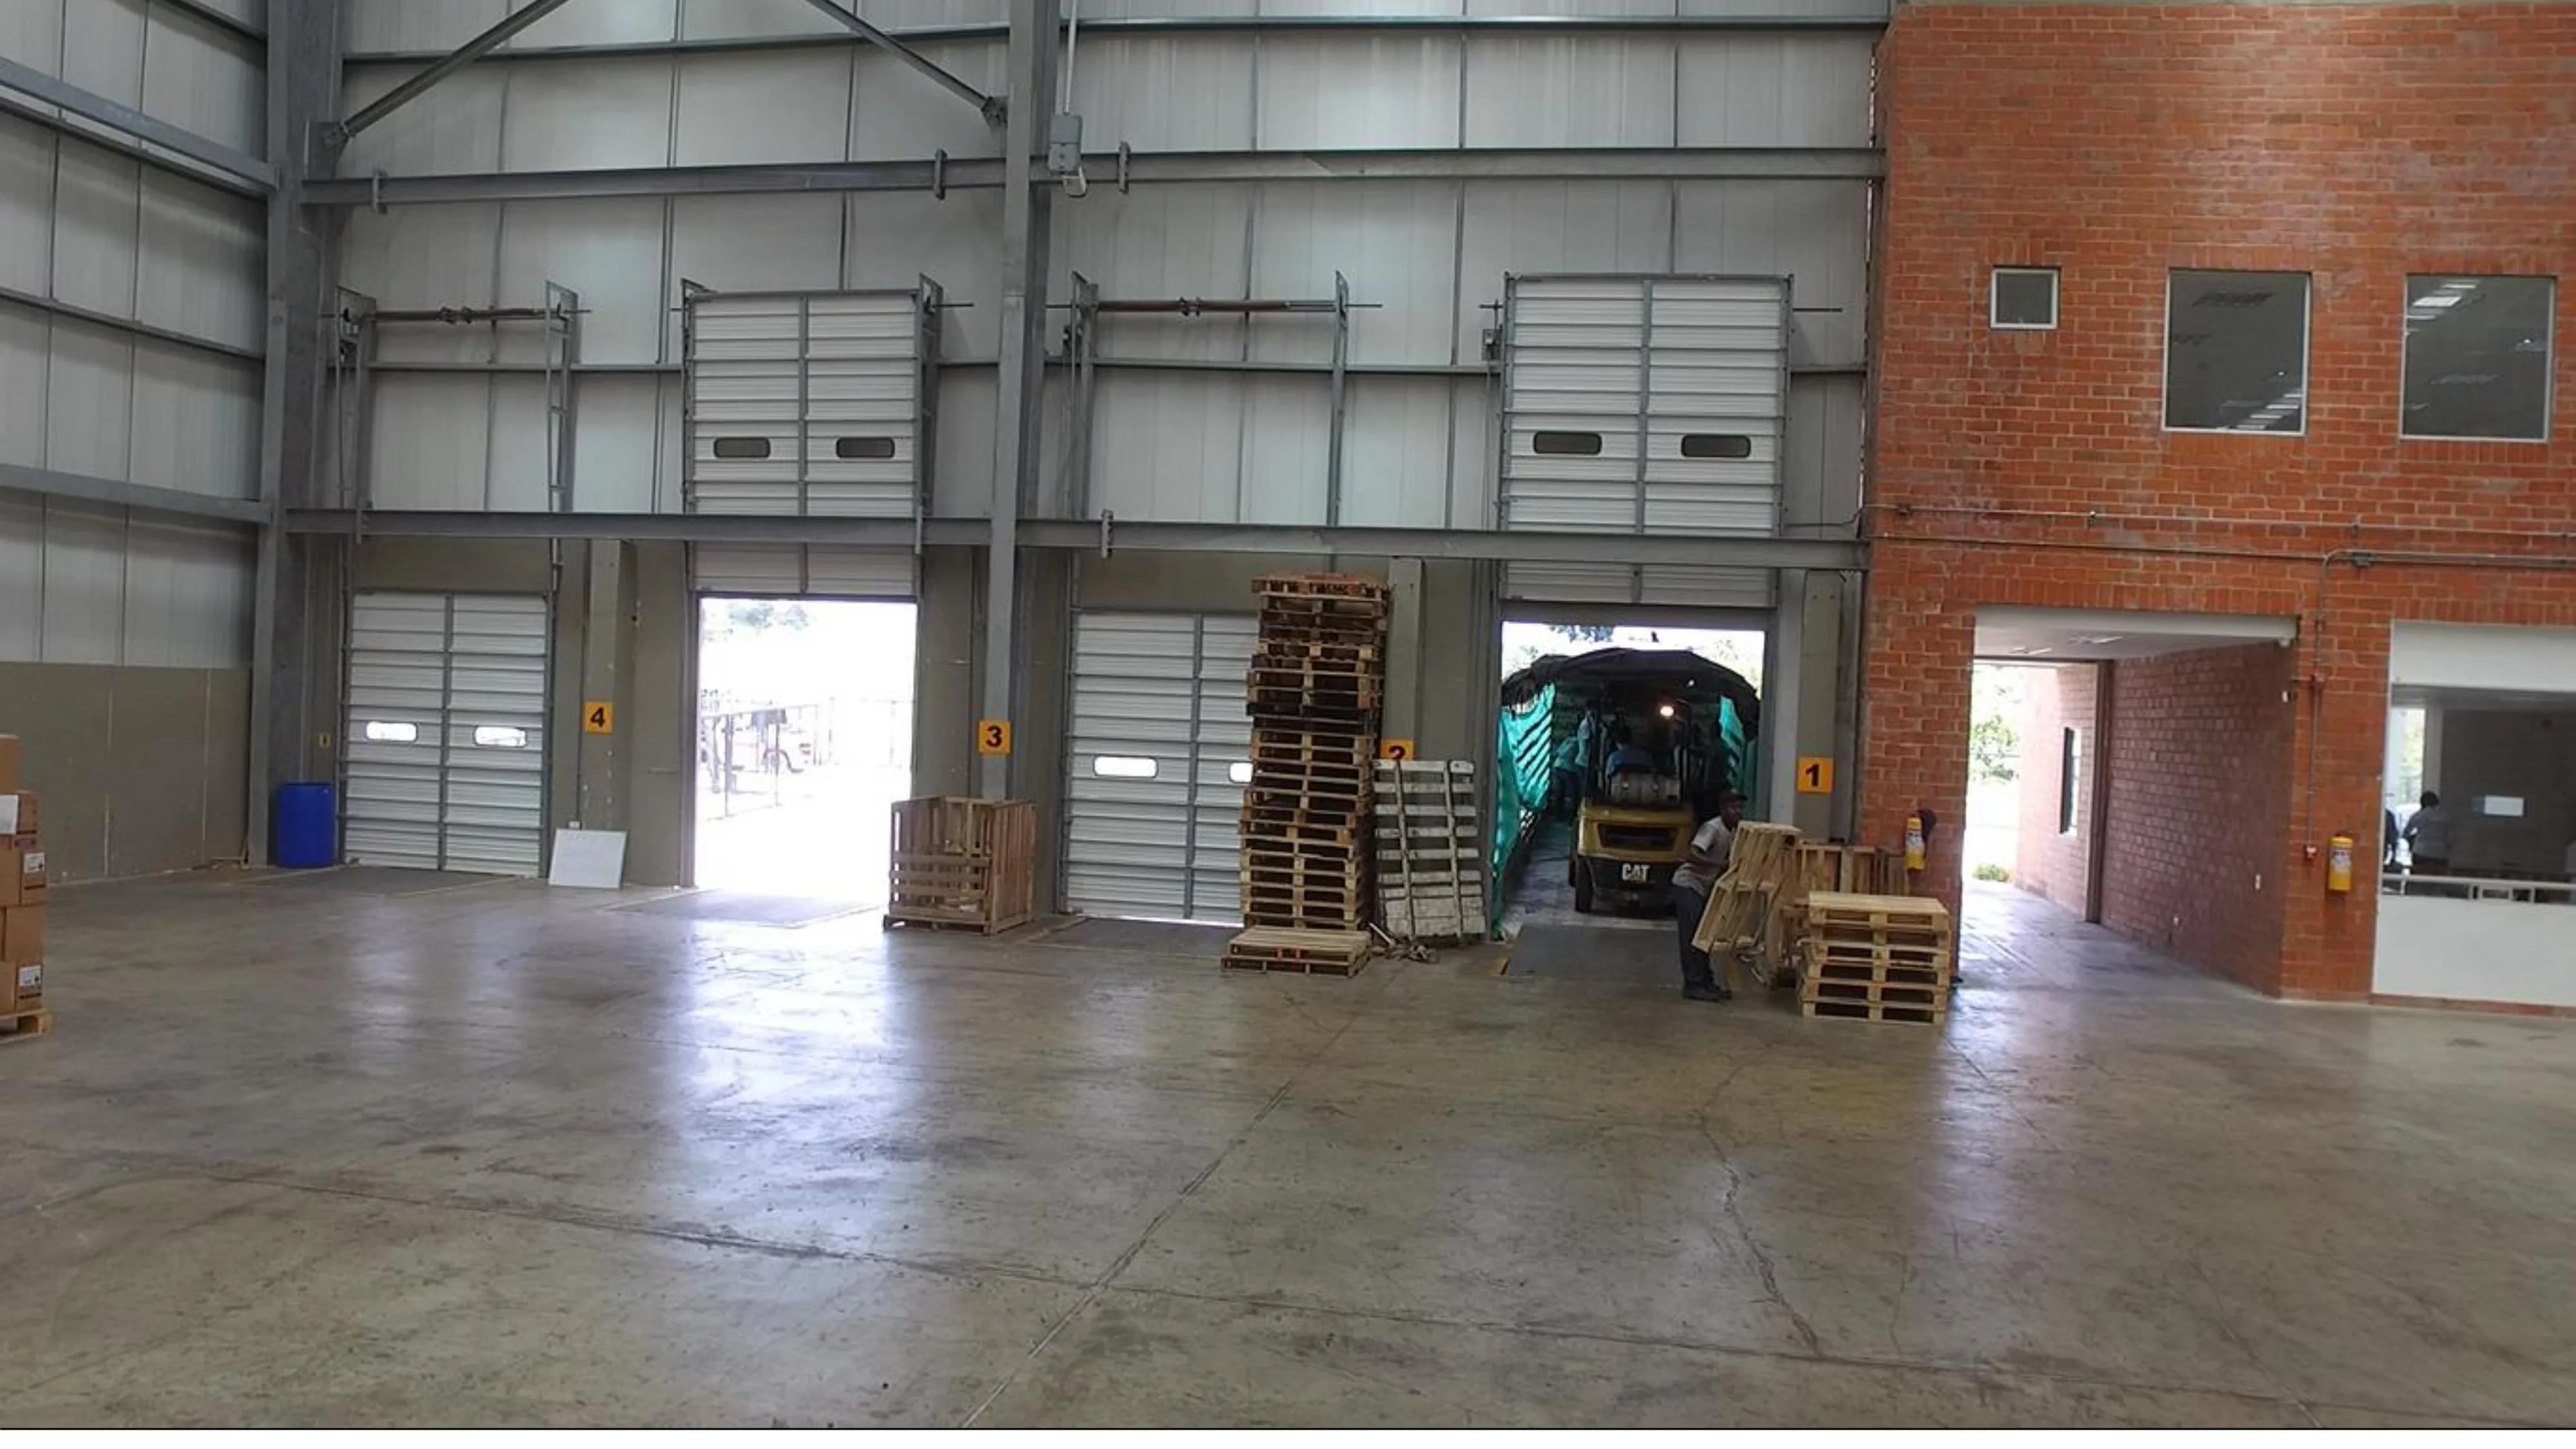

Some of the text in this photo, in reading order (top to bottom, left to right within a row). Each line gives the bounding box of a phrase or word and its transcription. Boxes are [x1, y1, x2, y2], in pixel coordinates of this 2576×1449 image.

[590, 706, 606, 728] 4
[986, 725, 1003, 748] 3
[1388, 745, 1406, 760] 2
[1805, 764, 1819, 787] 1
[1622, 863, 1651, 882] CAT
